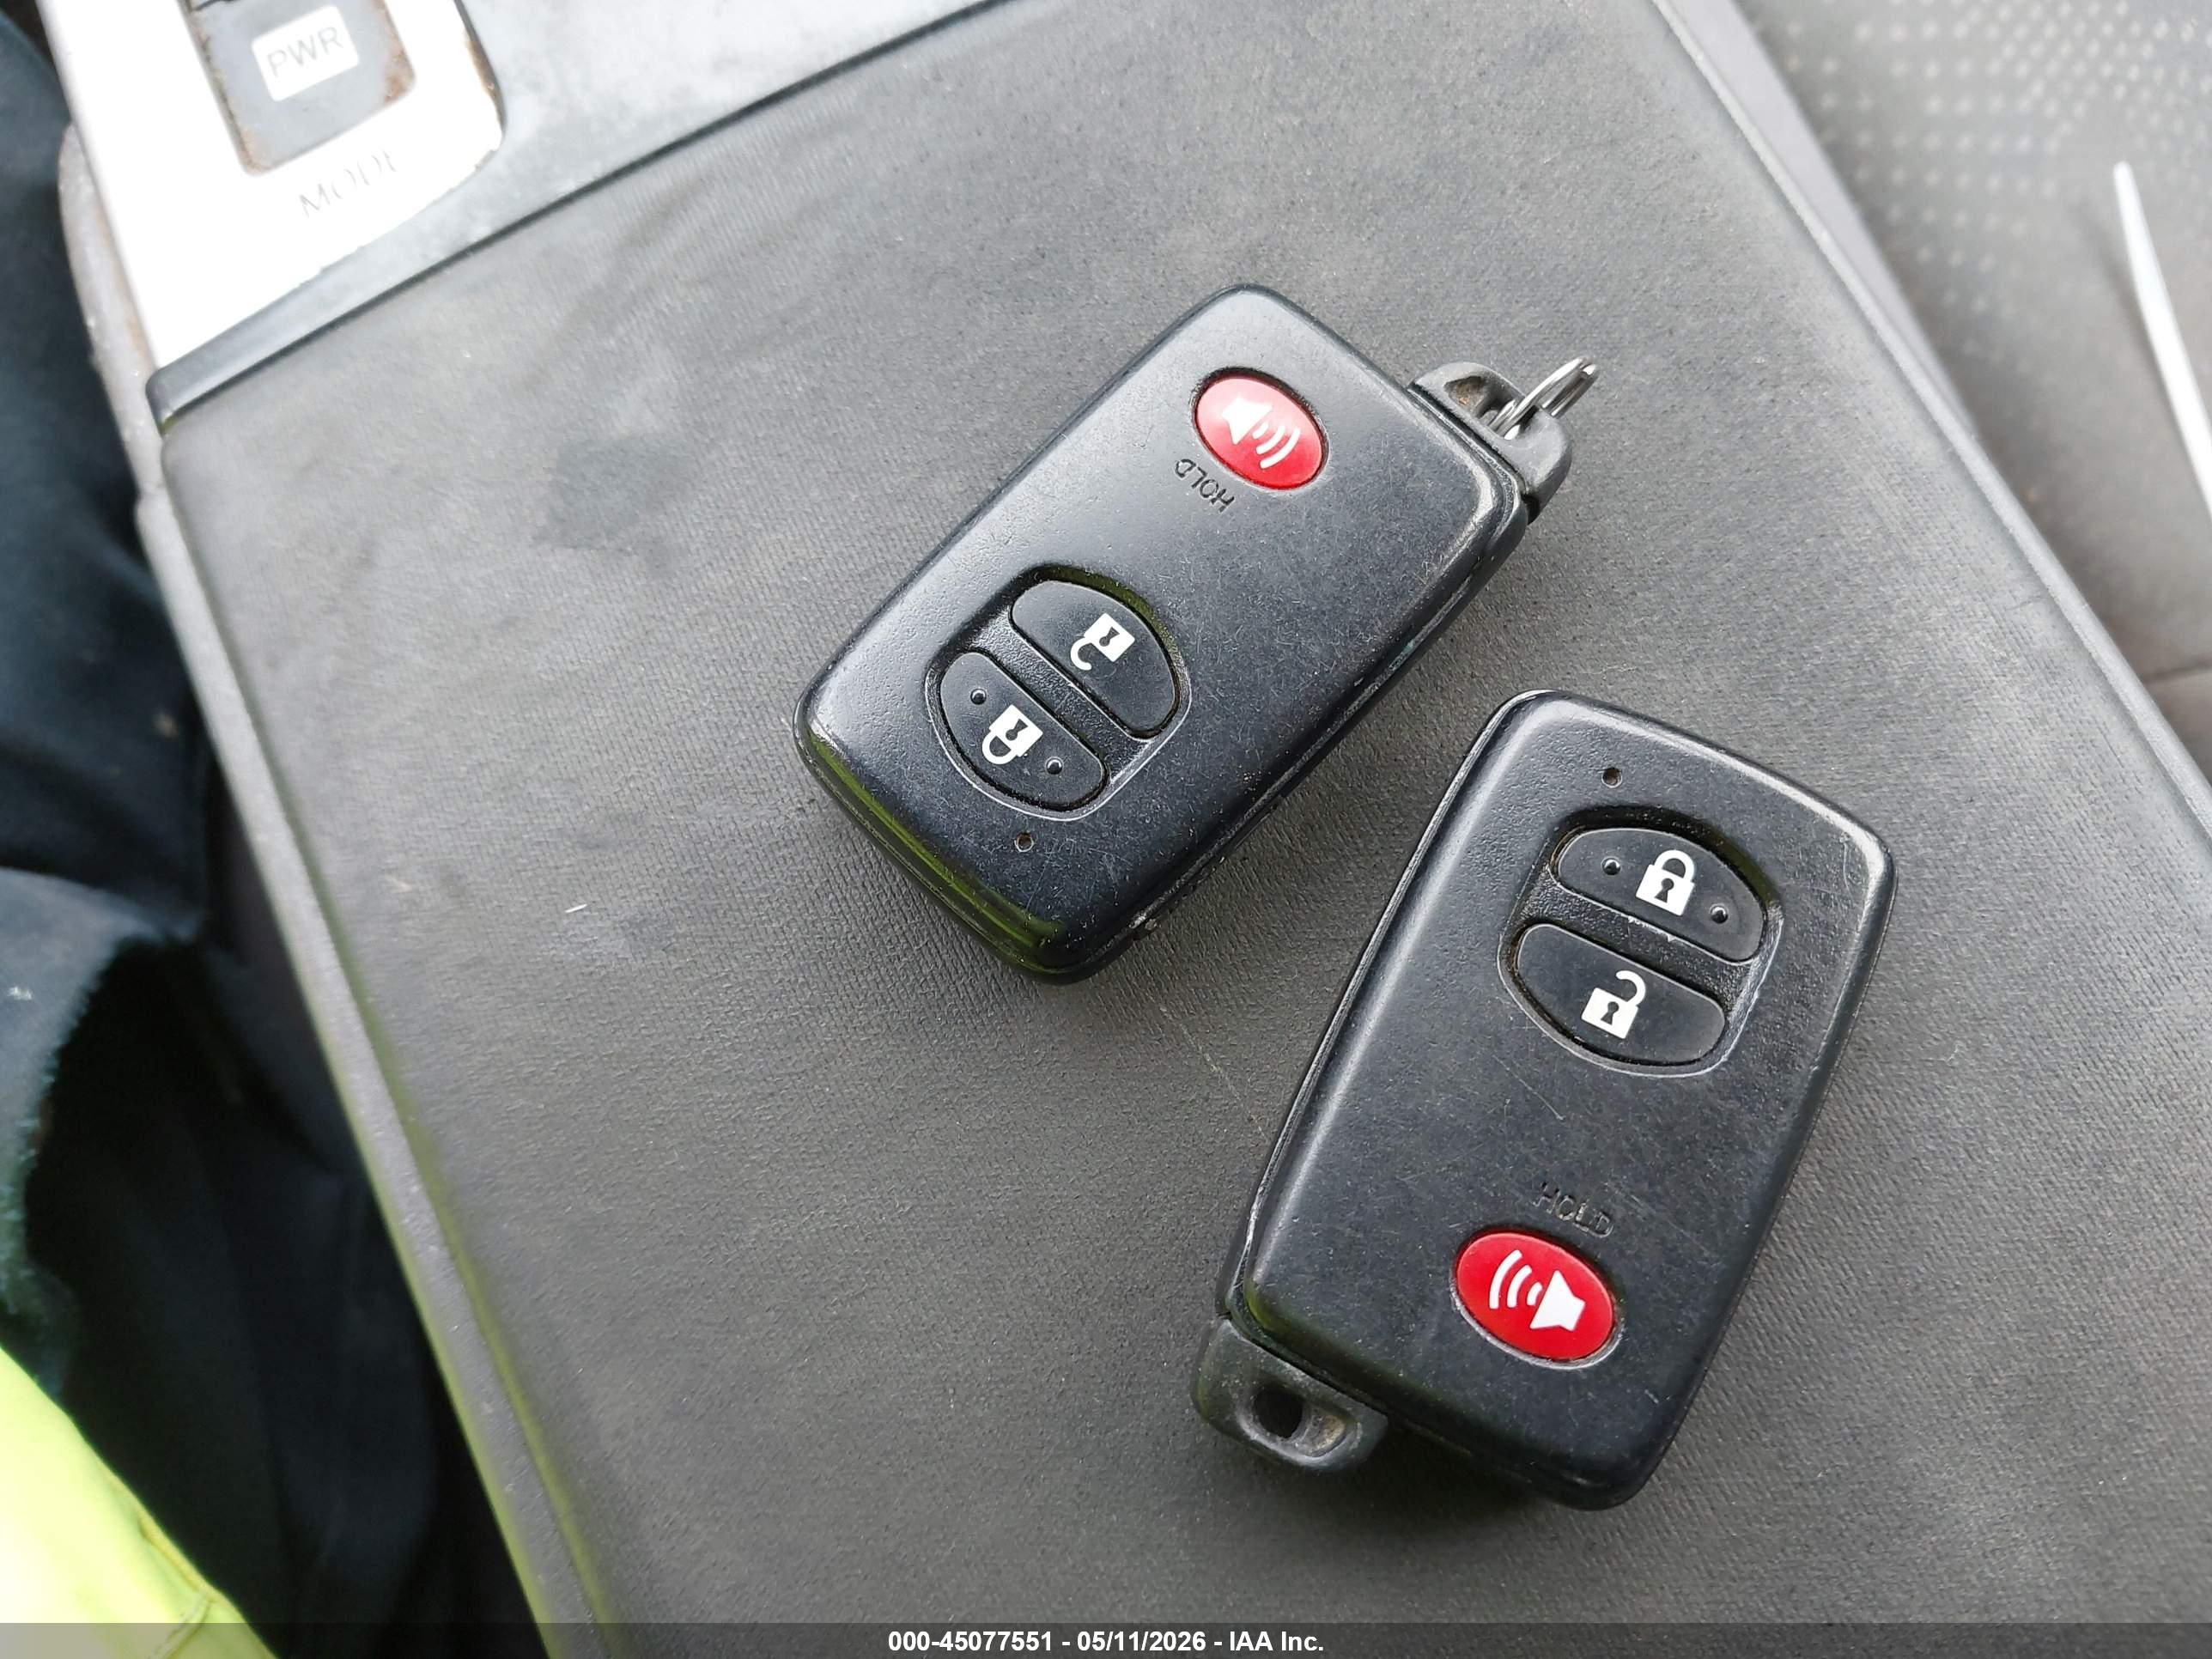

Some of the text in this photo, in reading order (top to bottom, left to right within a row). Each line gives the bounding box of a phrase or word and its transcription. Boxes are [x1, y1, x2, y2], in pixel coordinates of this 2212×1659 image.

[265, 25, 343, 78] PWR
[1174, 458, 1235, 514] HOLD
[1531, 1181, 1614, 1238] HOLD
